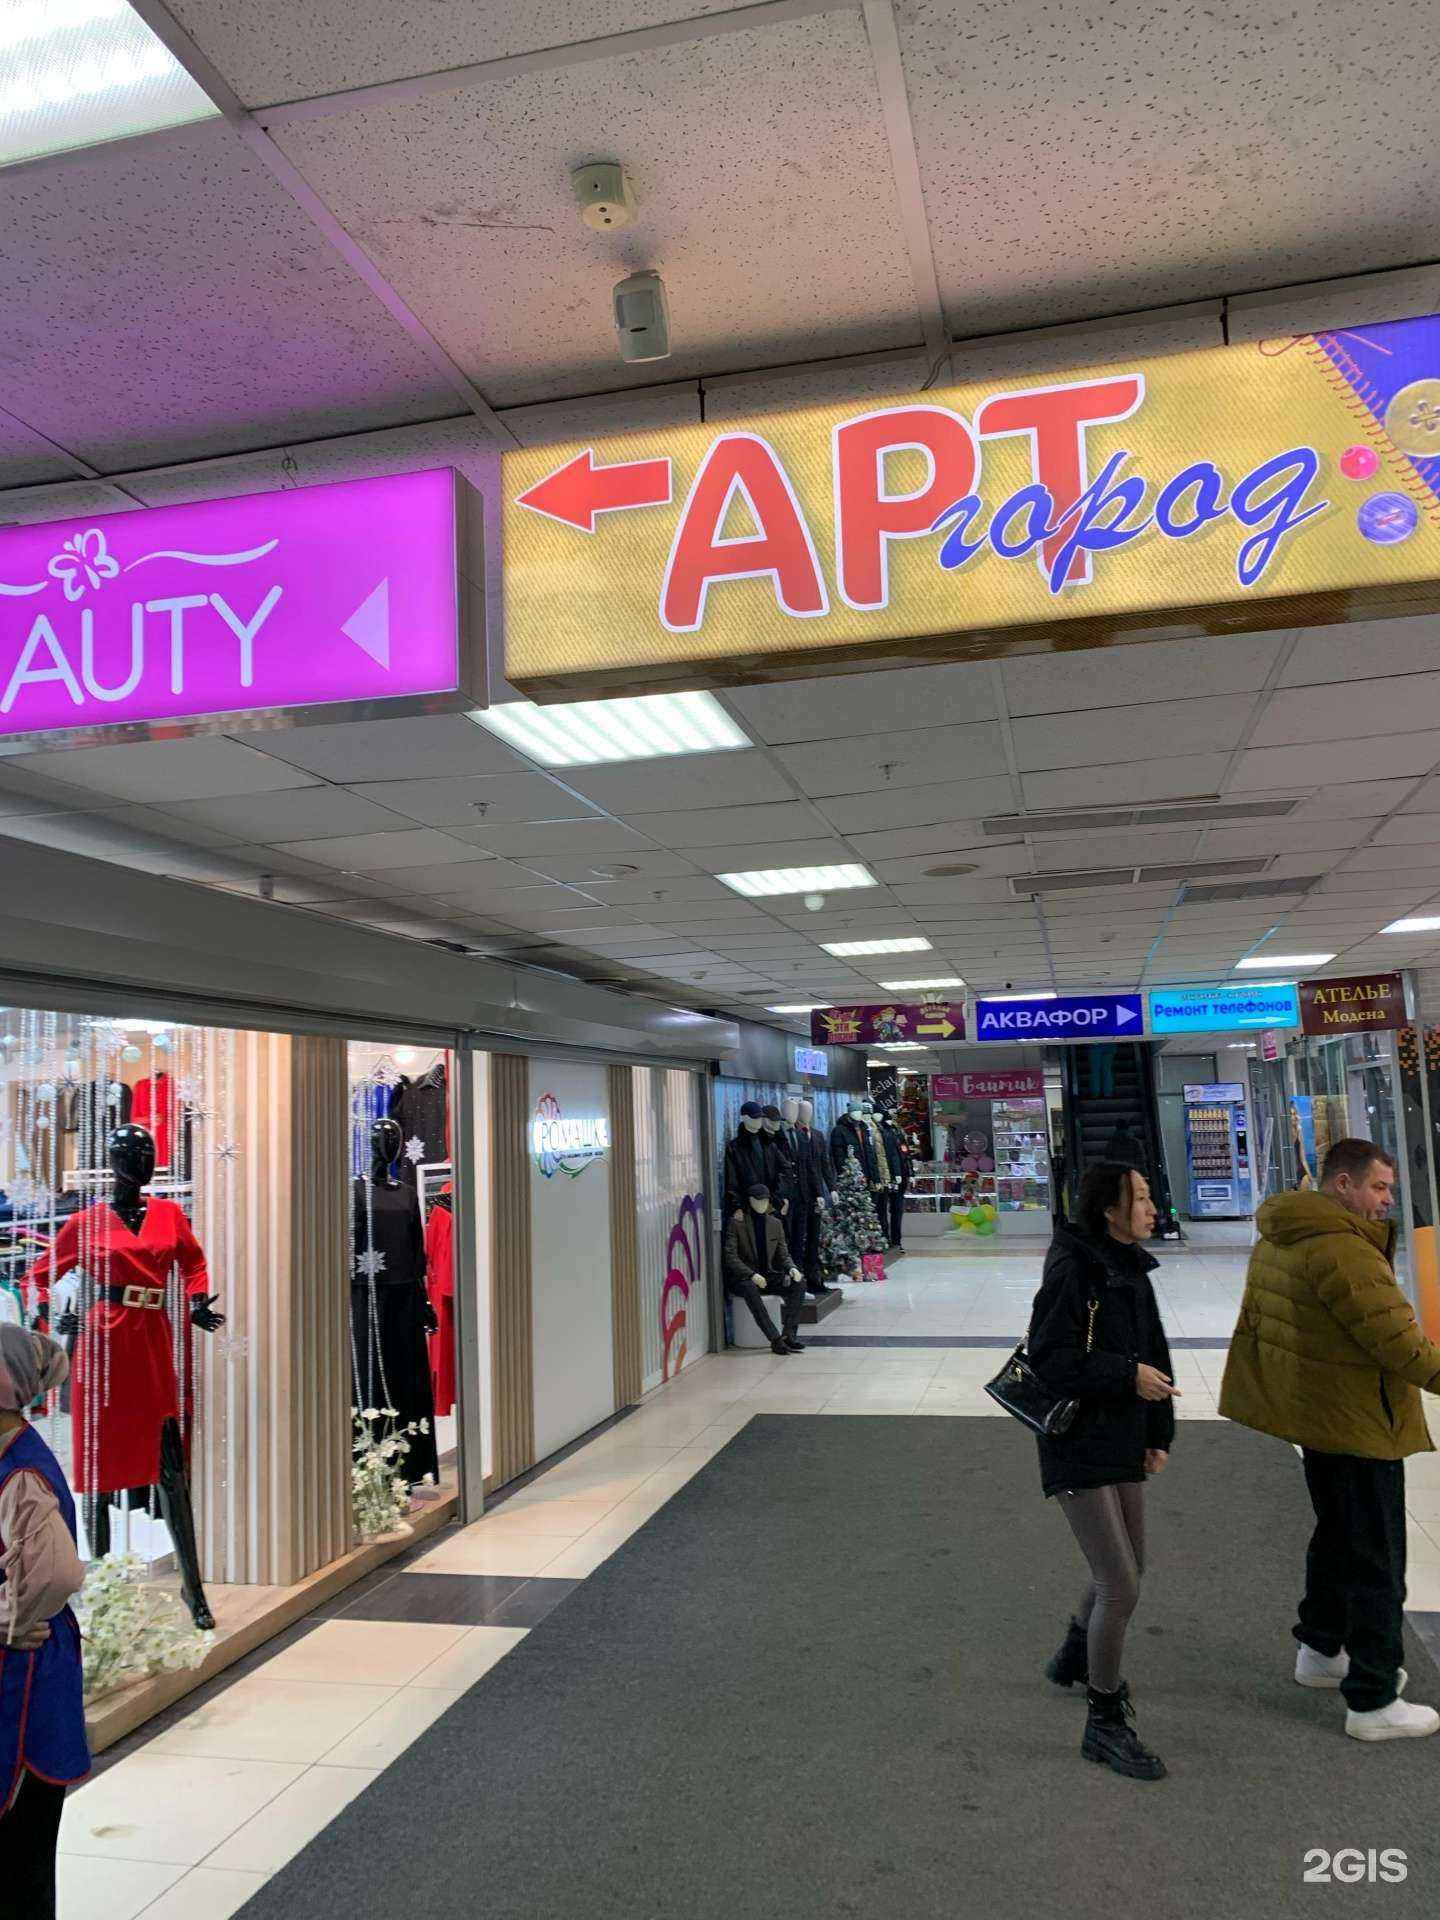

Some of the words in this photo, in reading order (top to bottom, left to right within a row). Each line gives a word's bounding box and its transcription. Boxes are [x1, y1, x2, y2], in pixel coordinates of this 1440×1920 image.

[659, 373, 1145, 633] АРТ
[930, 446, 1330, 592] город
[1312, 983, 1393, 1004] АТЕЛЬЕ
[981, 1007, 1108, 1030] АКВАФОР
[1154, 1003, 1209, 1018] Ремонт
[1212, 999, 1293, 1015] телефонов
